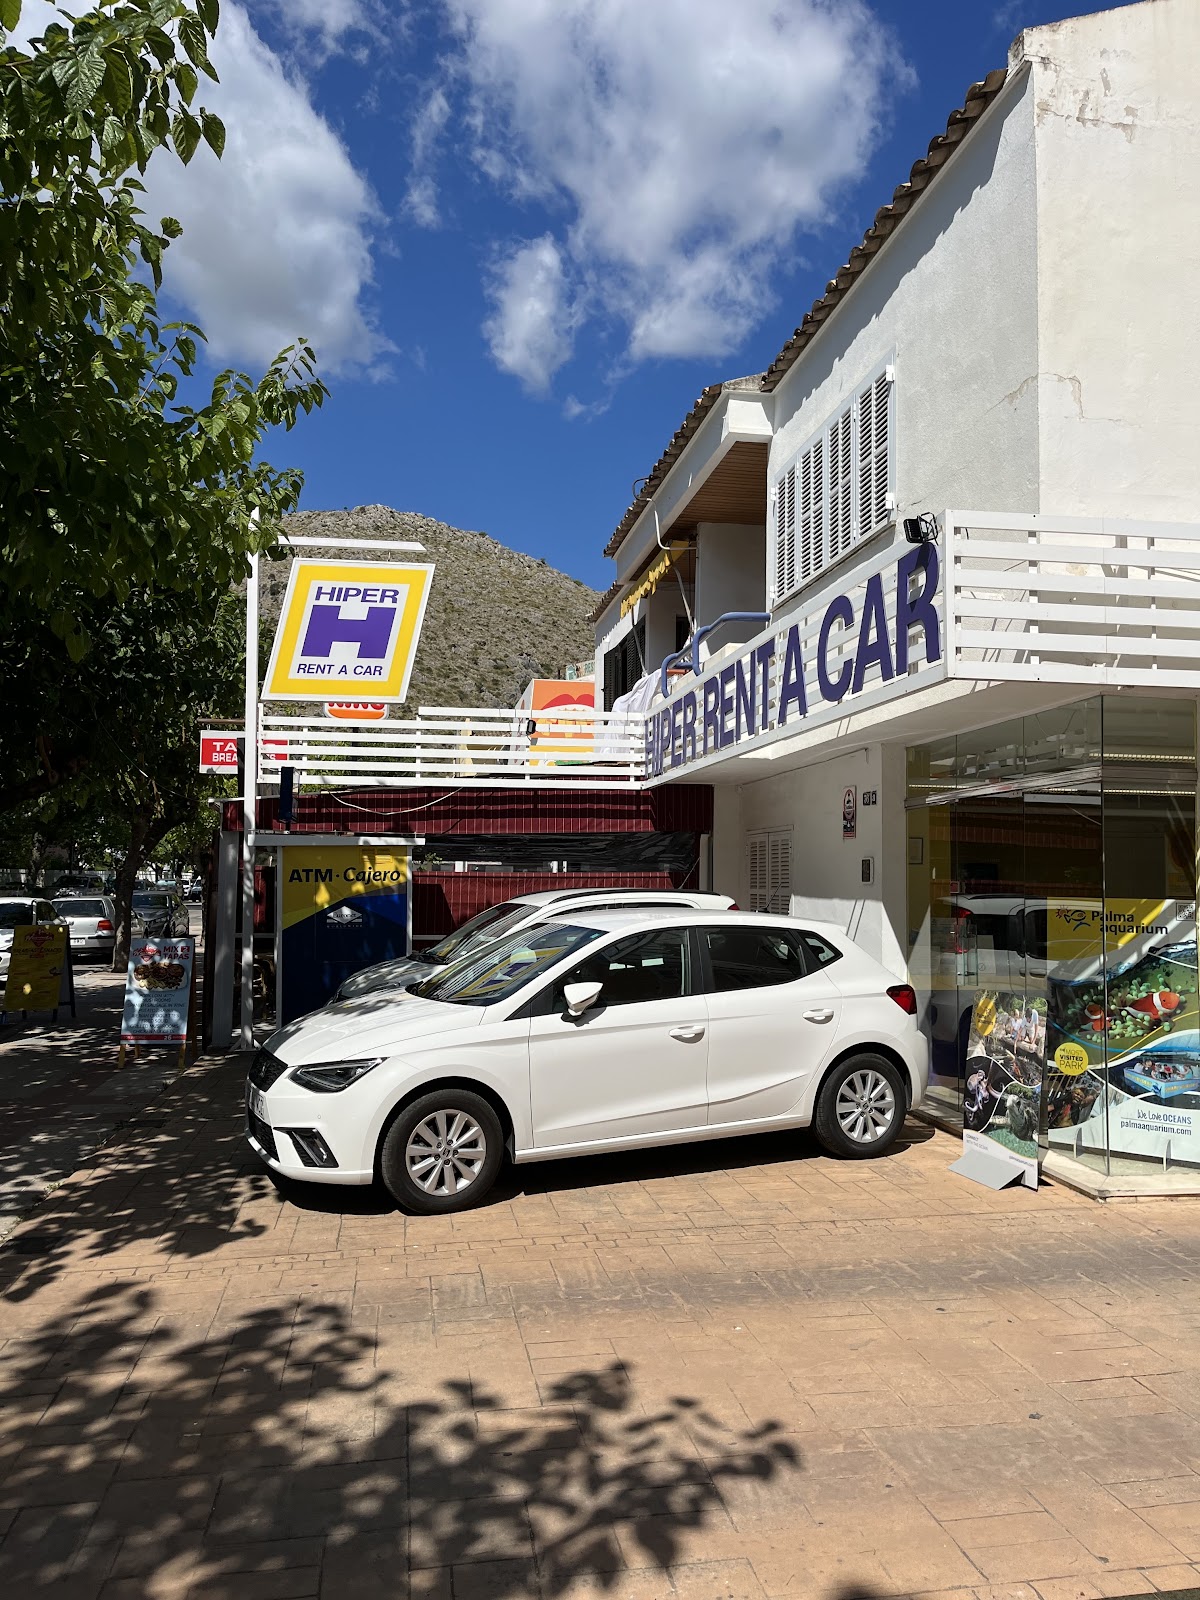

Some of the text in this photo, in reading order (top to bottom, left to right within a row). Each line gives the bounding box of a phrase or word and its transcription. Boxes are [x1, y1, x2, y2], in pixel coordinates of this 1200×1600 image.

[315, 586, 399, 604] HIPER
[645, 542, 941, 778] HIPER RENT A CAR
[297, 663, 383, 676] RENT A CAR
[289, 866, 401, 885] ATM Cajero
[1091, 911, 1135, 923] Palma
[1100, 923, 1168, 935] aquarium
[163, 945, 180, 953] MIX
[1060, 1054, 1084, 1062] VISITED
[1060, 1060, 1084, 1070] PARK
[1148, 1110, 1163, 1121] Love
[1163, 1113, 1192, 1125] OCEANS
[1120, 1120, 1192, 1136] palmaaquarium.com
